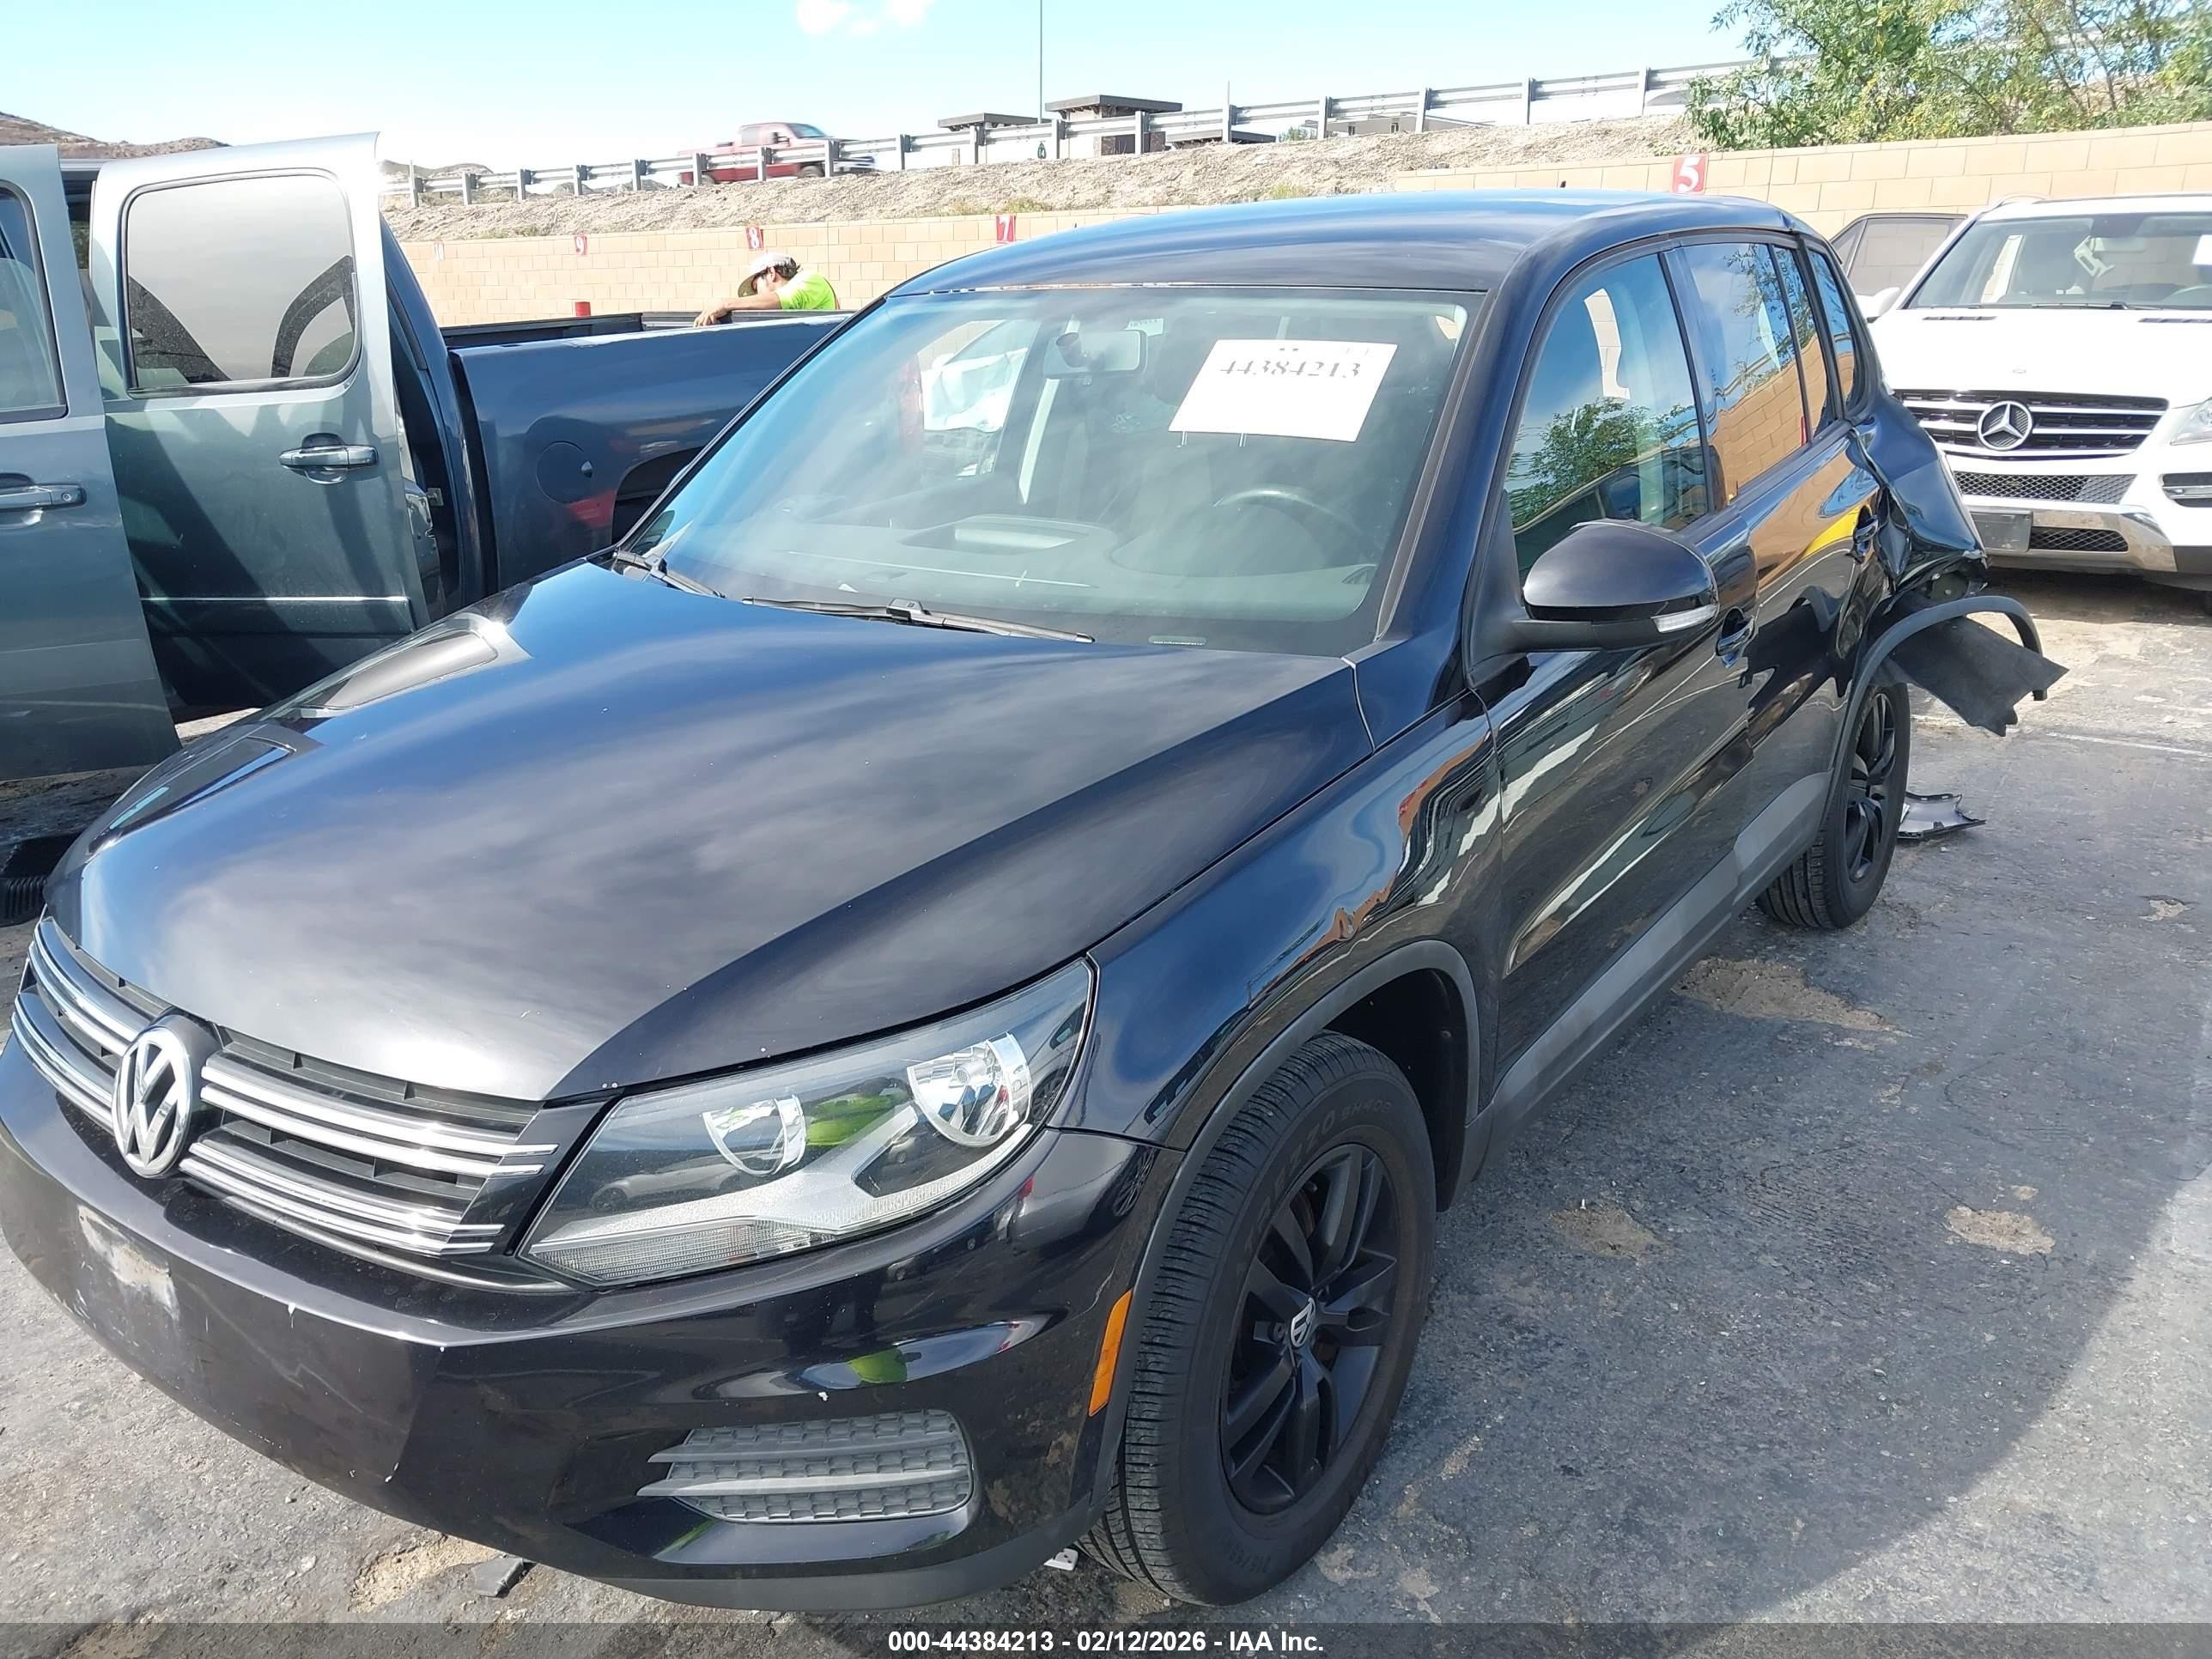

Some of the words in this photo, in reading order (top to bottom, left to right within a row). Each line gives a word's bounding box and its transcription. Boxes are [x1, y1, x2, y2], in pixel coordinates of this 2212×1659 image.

[1676, 155, 1700, 192] 5
[748, 227, 760, 248] 8
[998, 214, 1012, 241] 7
[575, 236, 585, 255] 9
[1219, 359, 1362, 379] 44384213
